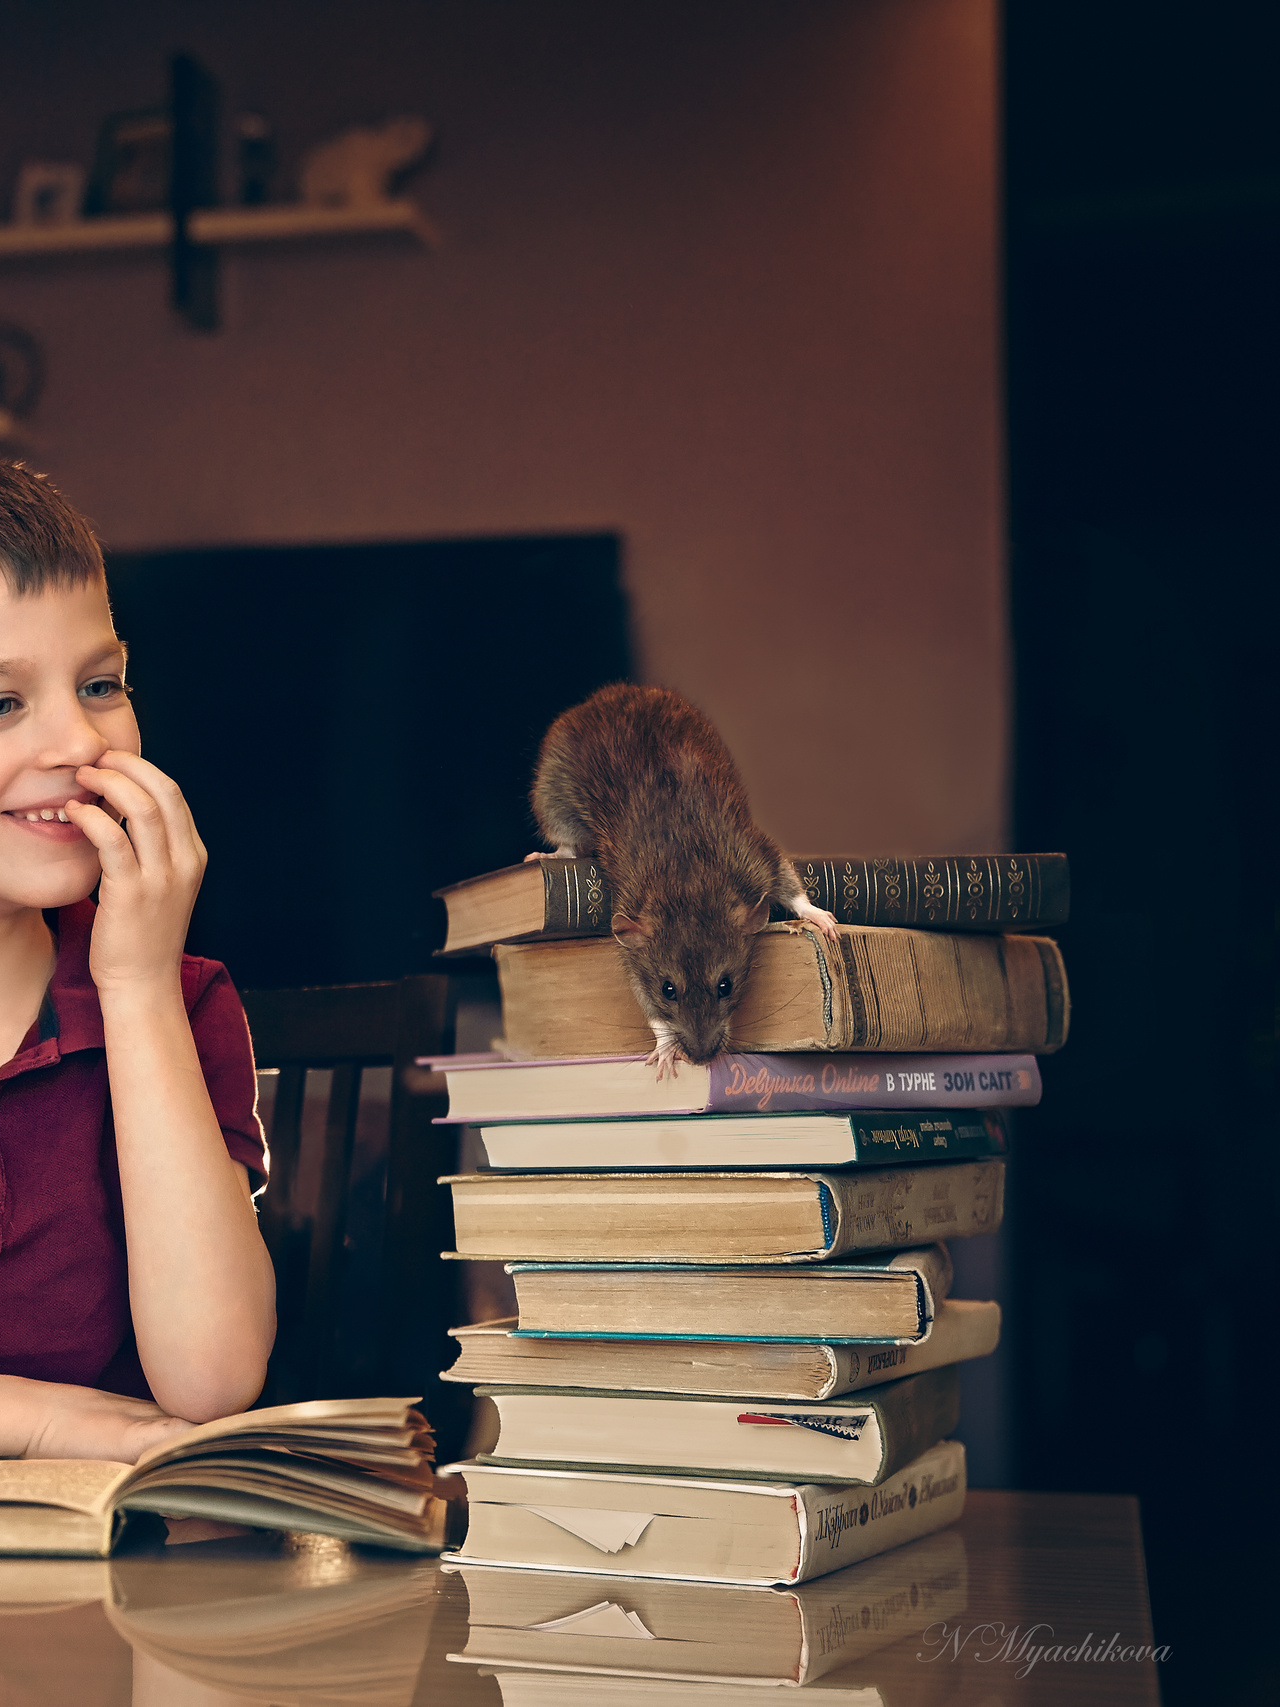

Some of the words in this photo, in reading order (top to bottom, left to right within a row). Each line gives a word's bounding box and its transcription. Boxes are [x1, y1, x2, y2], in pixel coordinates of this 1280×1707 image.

[725, 1062, 816, 1109] Девушка
[821, 1063, 880, 1094] Online
[886, 1073, 895, 1092] В
[898, 1072, 936, 1092] ТУРНЕ
[944, 1072, 975, 1092] ЗОИ
[979, 1070, 1013, 1091] САГГ
